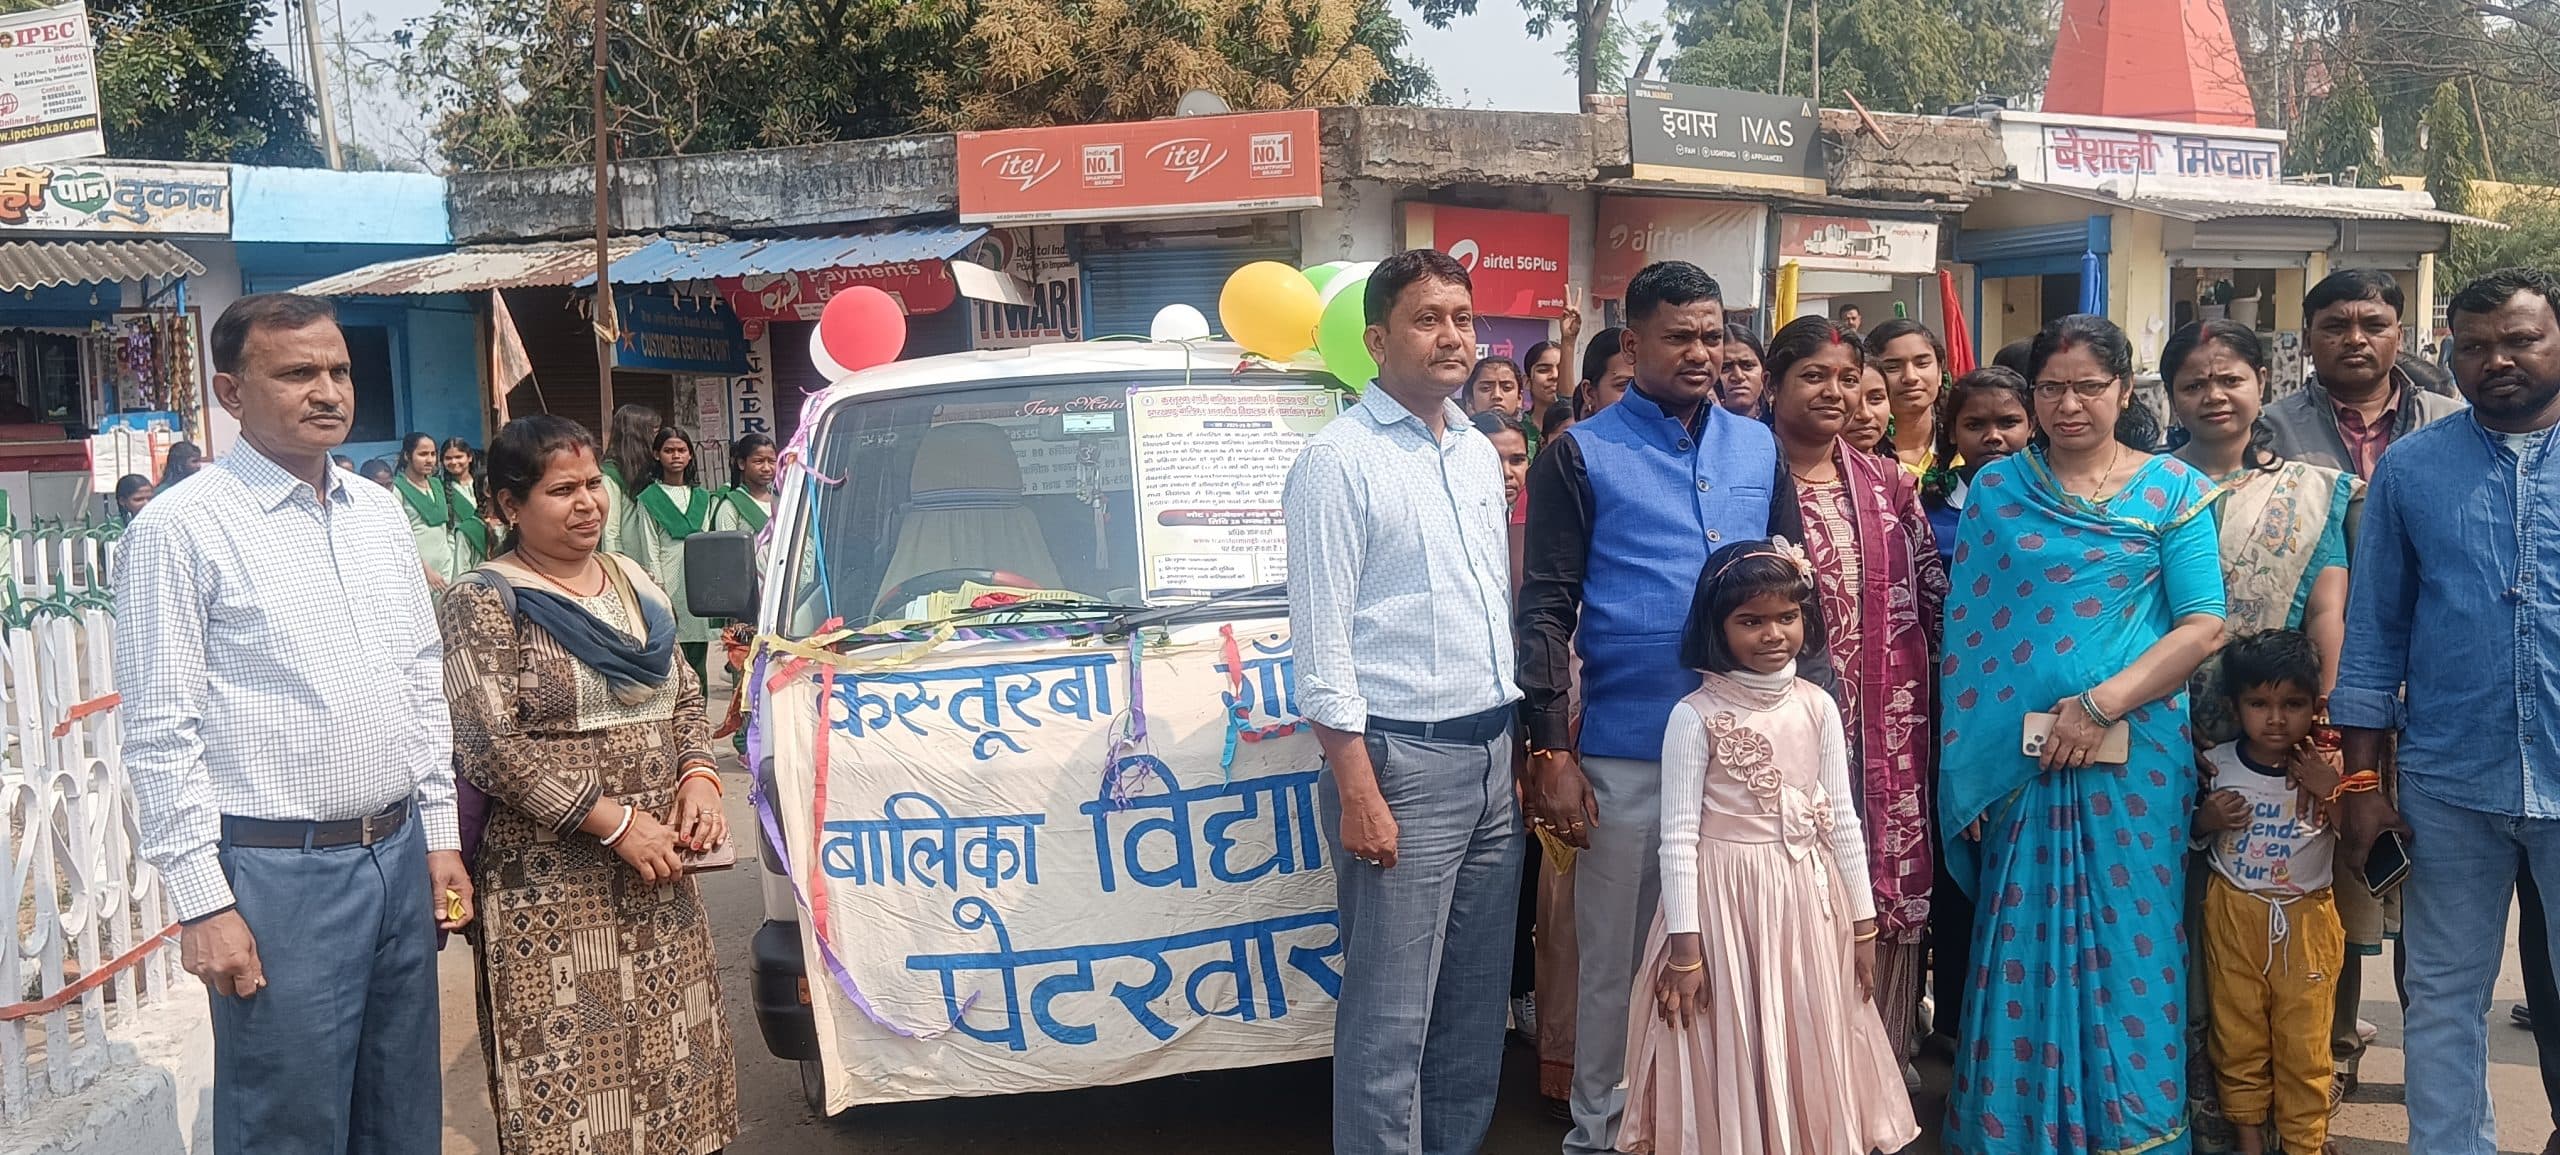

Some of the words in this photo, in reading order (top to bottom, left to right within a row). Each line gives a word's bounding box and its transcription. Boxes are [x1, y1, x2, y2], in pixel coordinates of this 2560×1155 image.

[15, 21, 75, 47] IPEC
[55, 52, 87, 64] Address
[41, 85, 66, 94] Contact
[1659, 106, 1718, 139] इवास
[1740, 115, 1794, 148] IVAS
[1000, 152, 1046, 176] itel
[1164, 143, 1212, 167] itel
[2051, 127, 2163, 177] बैशाली
[98, 177, 230, 225] दुकान
[1632, 222, 1694, 253] airtel
[1016, 244, 1051, 259] Digtal
[1482, 253, 1514, 270] airtel
[807, 262, 921, 284] Payments
[641, 332, 682, 360] CUSTOMER
[682, 335, 711, 361] SERVICE
[1015, 400, 1060, 417] Jay
[812, 653, 1117, 760] कस्तूरबा
[821, 791, 1046, 892] बालिका
[905, 896, 1344, 1052] पेटरवार
